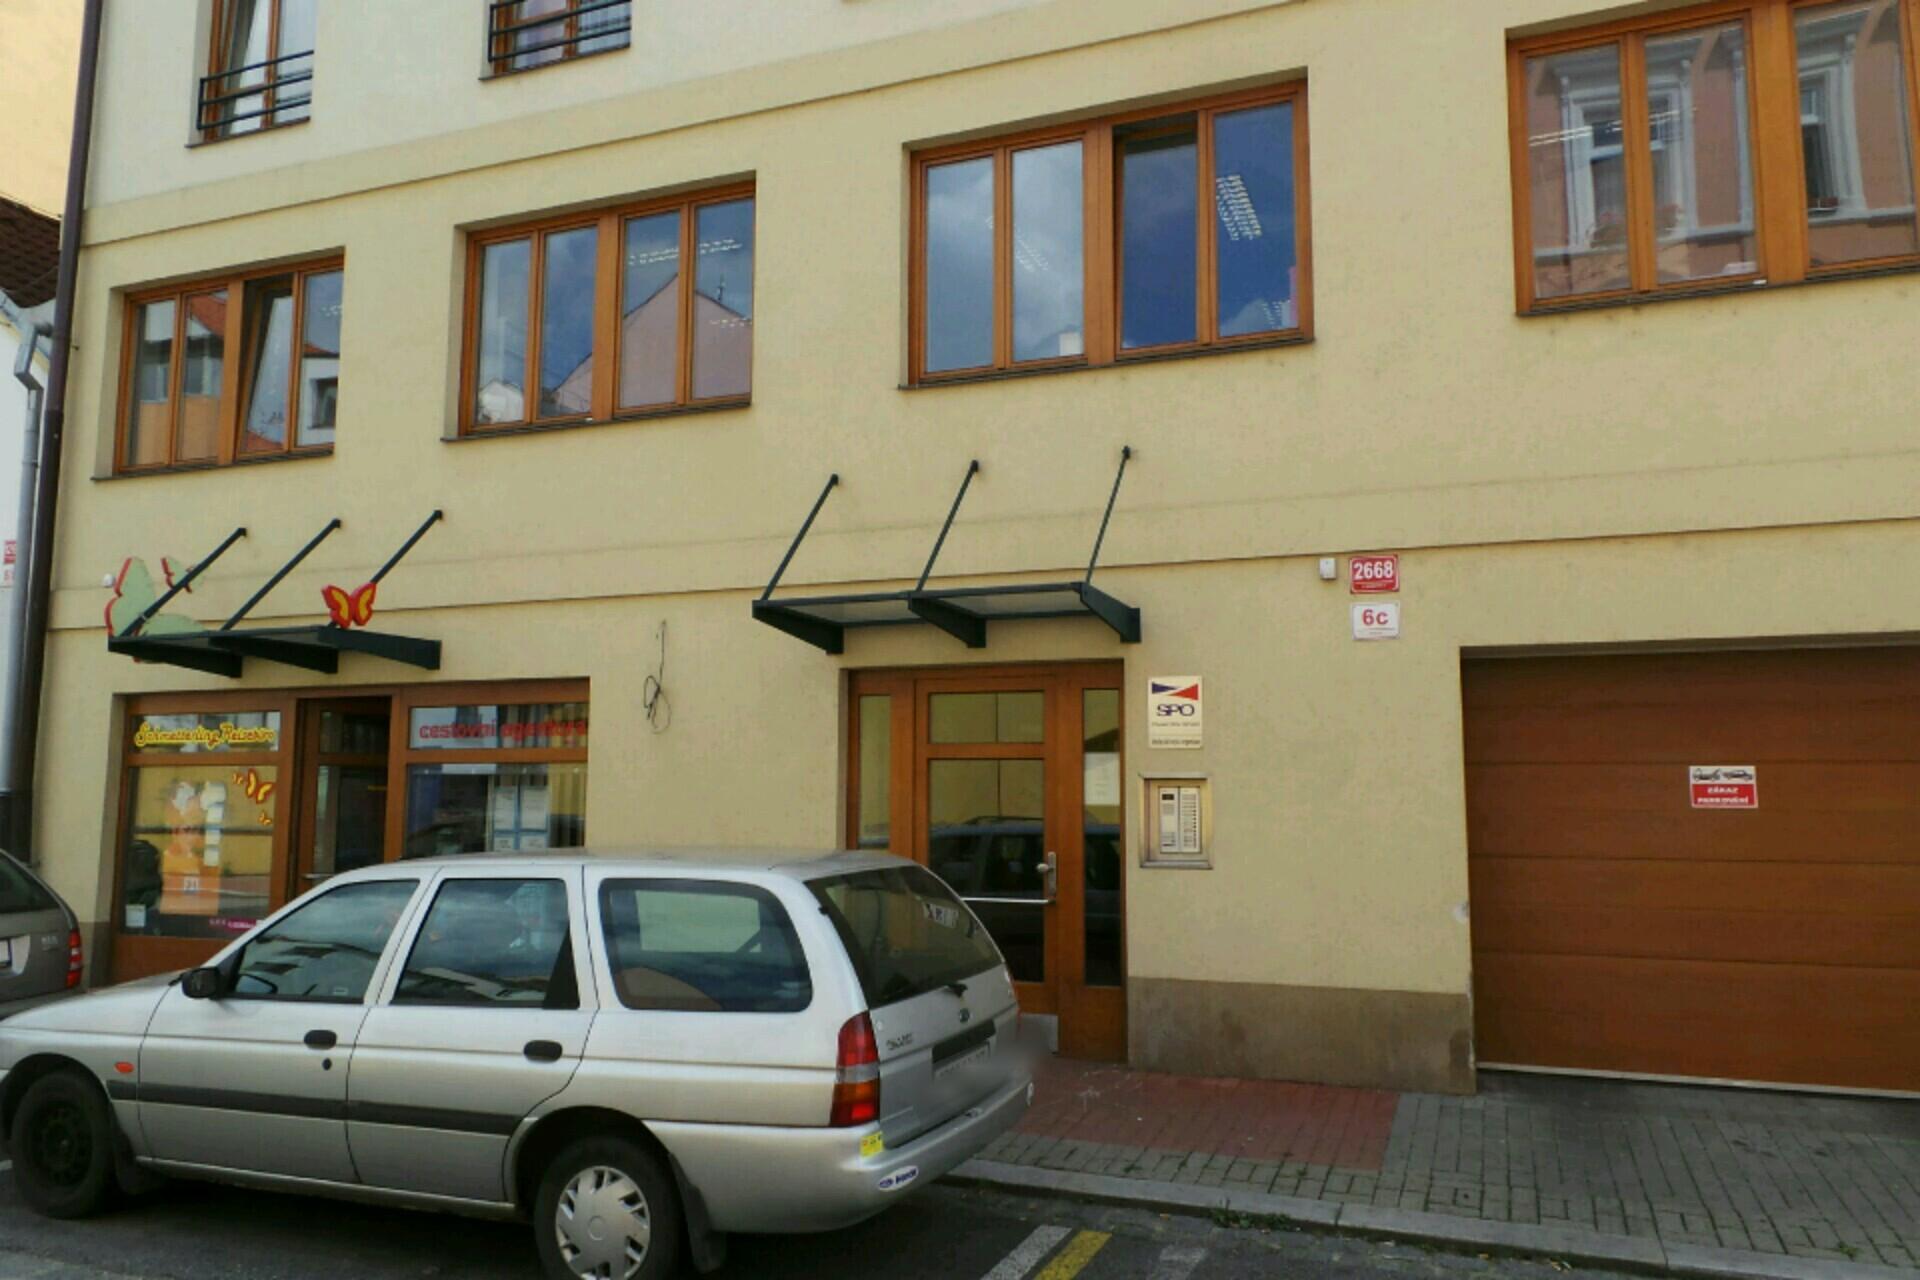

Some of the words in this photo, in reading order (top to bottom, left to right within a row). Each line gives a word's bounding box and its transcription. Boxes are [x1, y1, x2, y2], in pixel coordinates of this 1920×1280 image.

[1353, 560, 1393, 580] 2668
[1362, 608, 1389, 626] 6c
[1156, 703, 1195, 717] SPO
[134, 720, 221, 749] Schmetterling
